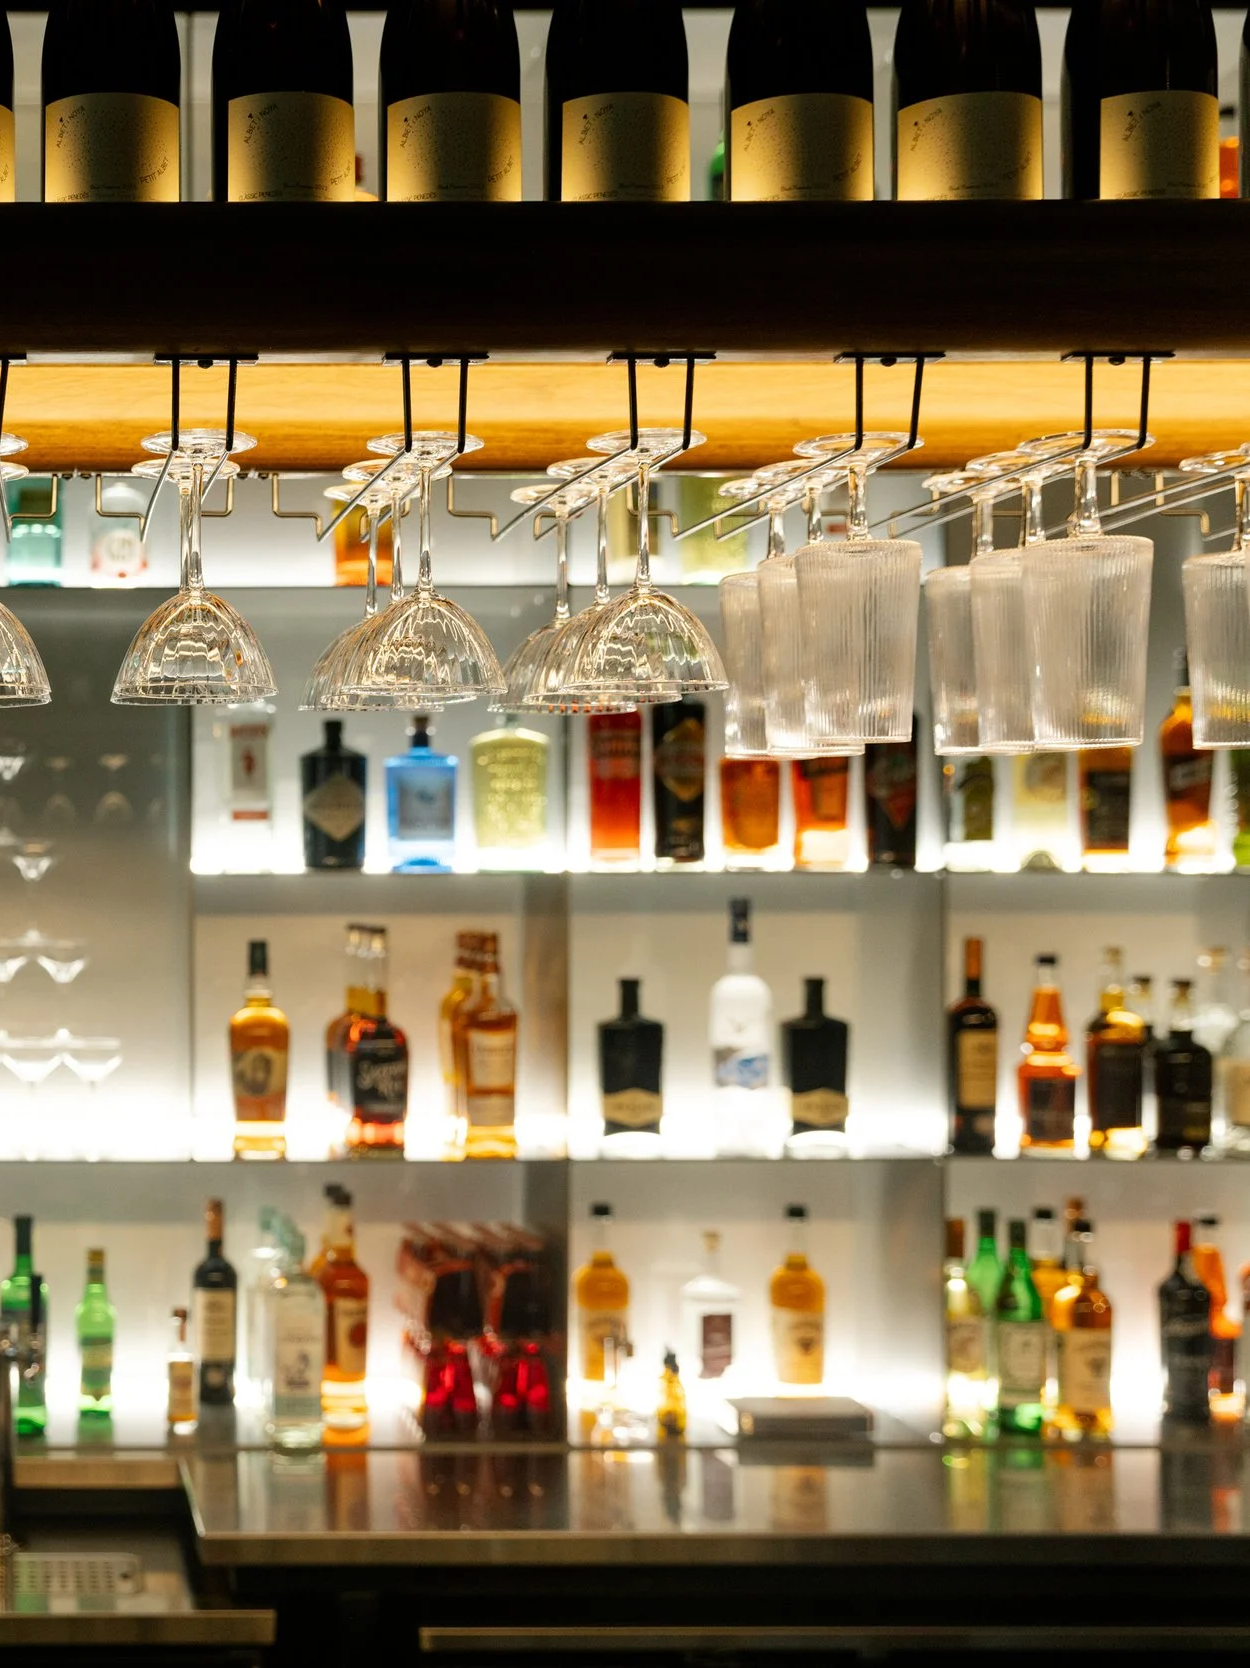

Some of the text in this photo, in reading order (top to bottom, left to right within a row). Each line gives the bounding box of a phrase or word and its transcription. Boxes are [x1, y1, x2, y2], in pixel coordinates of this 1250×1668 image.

[56, 123, 67, 148] ALBET
[68, 105, 86, 121] NOYA
[244, 120, 257, 145] ALBET
[259, 103, 279, 117] NOYA
[400, 123, 411, 148] ALBET
[414, 105, 432, 121] NOYA
[138, 156, 169, 184] PETIT ALBET
